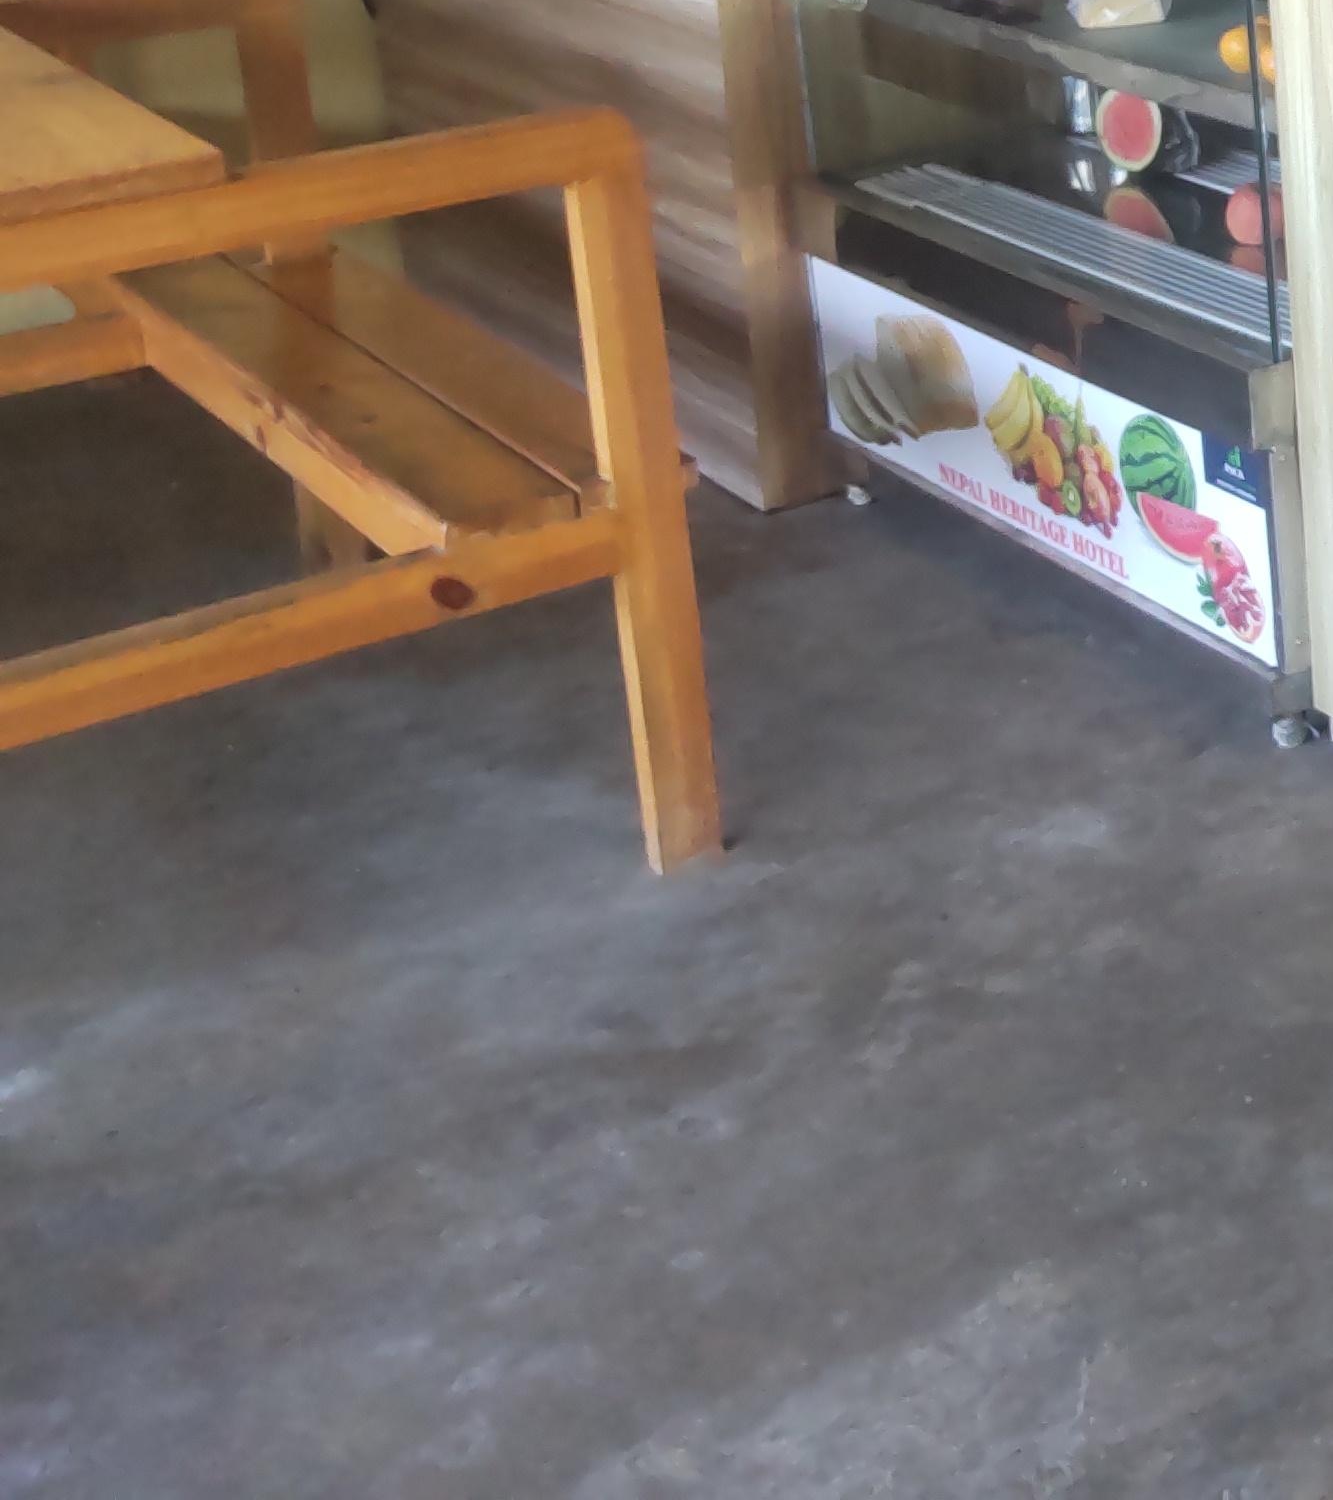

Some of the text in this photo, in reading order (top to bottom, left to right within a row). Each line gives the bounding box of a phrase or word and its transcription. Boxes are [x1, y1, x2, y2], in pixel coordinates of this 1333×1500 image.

[937, 461, 1130, 581] NEPAL HERITAGE HOTEL
